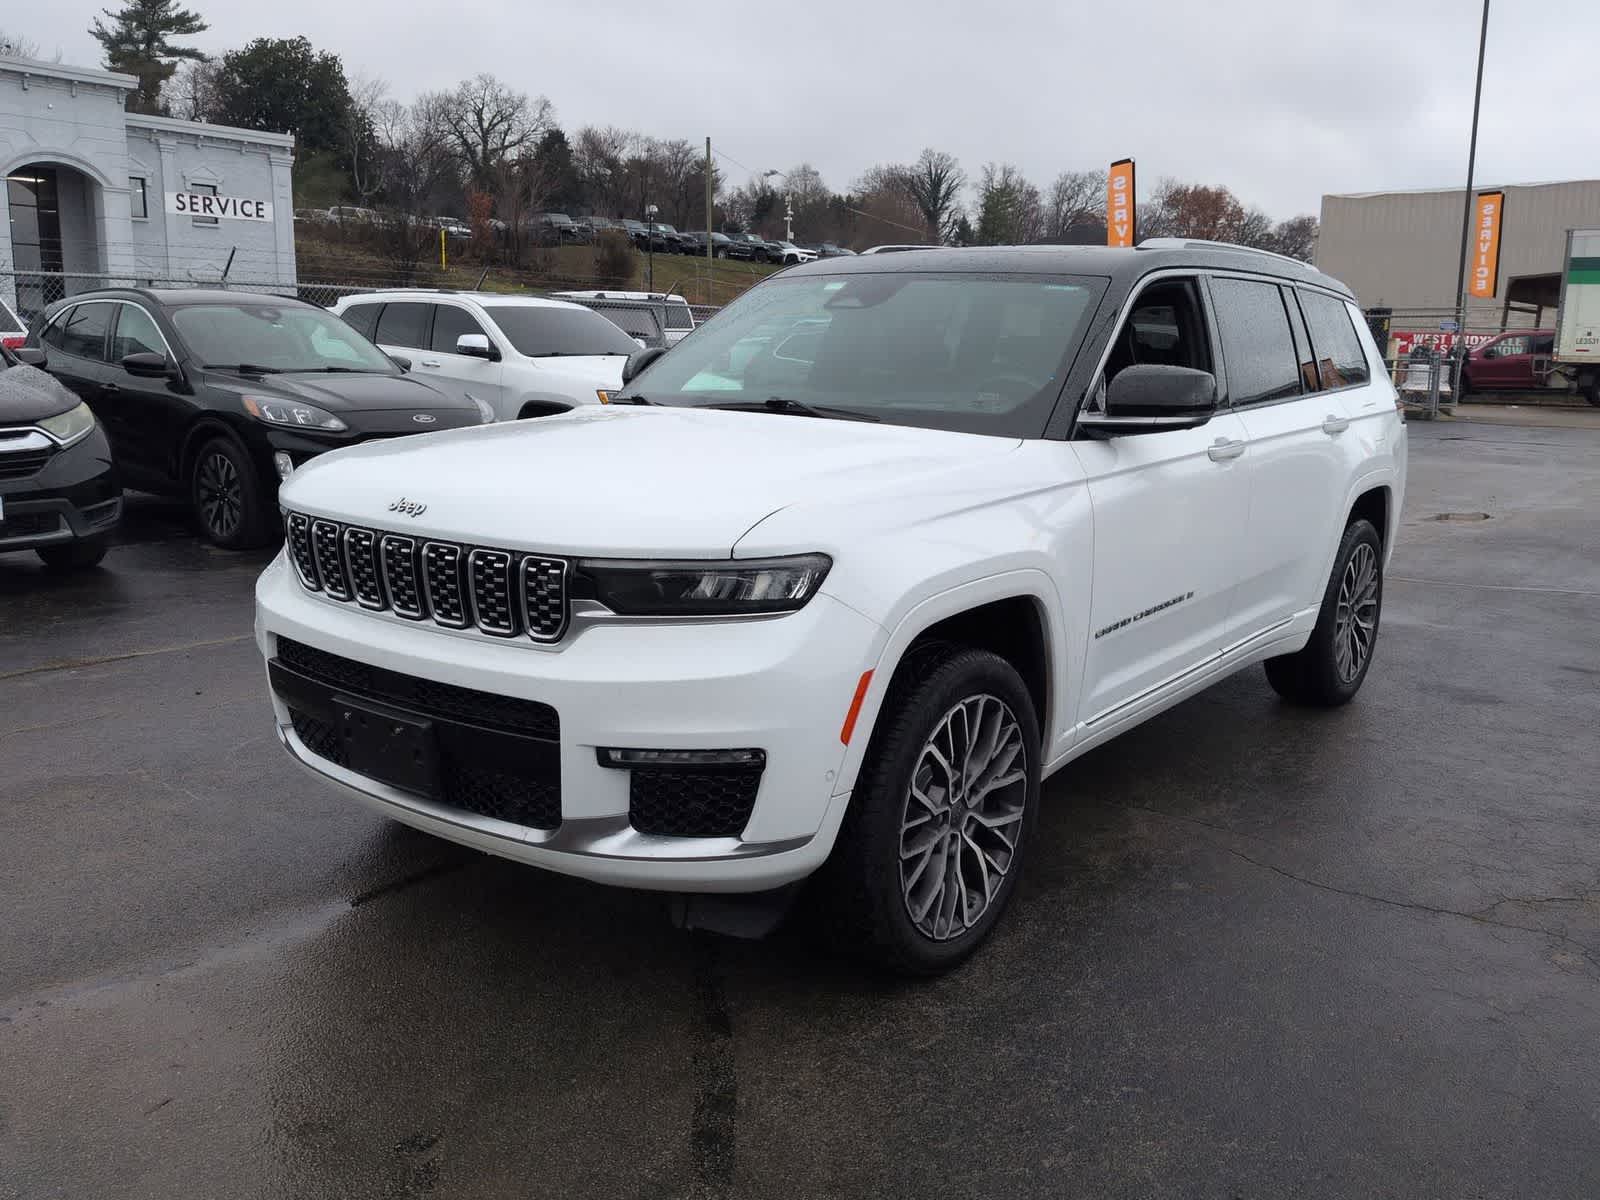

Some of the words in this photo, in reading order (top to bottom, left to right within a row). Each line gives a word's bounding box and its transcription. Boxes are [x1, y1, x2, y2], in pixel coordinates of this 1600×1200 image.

[176, 193, 265, 218] SERVICE
[1413, 334, 1447, 344] WEST
[1451, 334, 1522, 346] KOXLLE
[389, 497, 427, 518] Jeep
